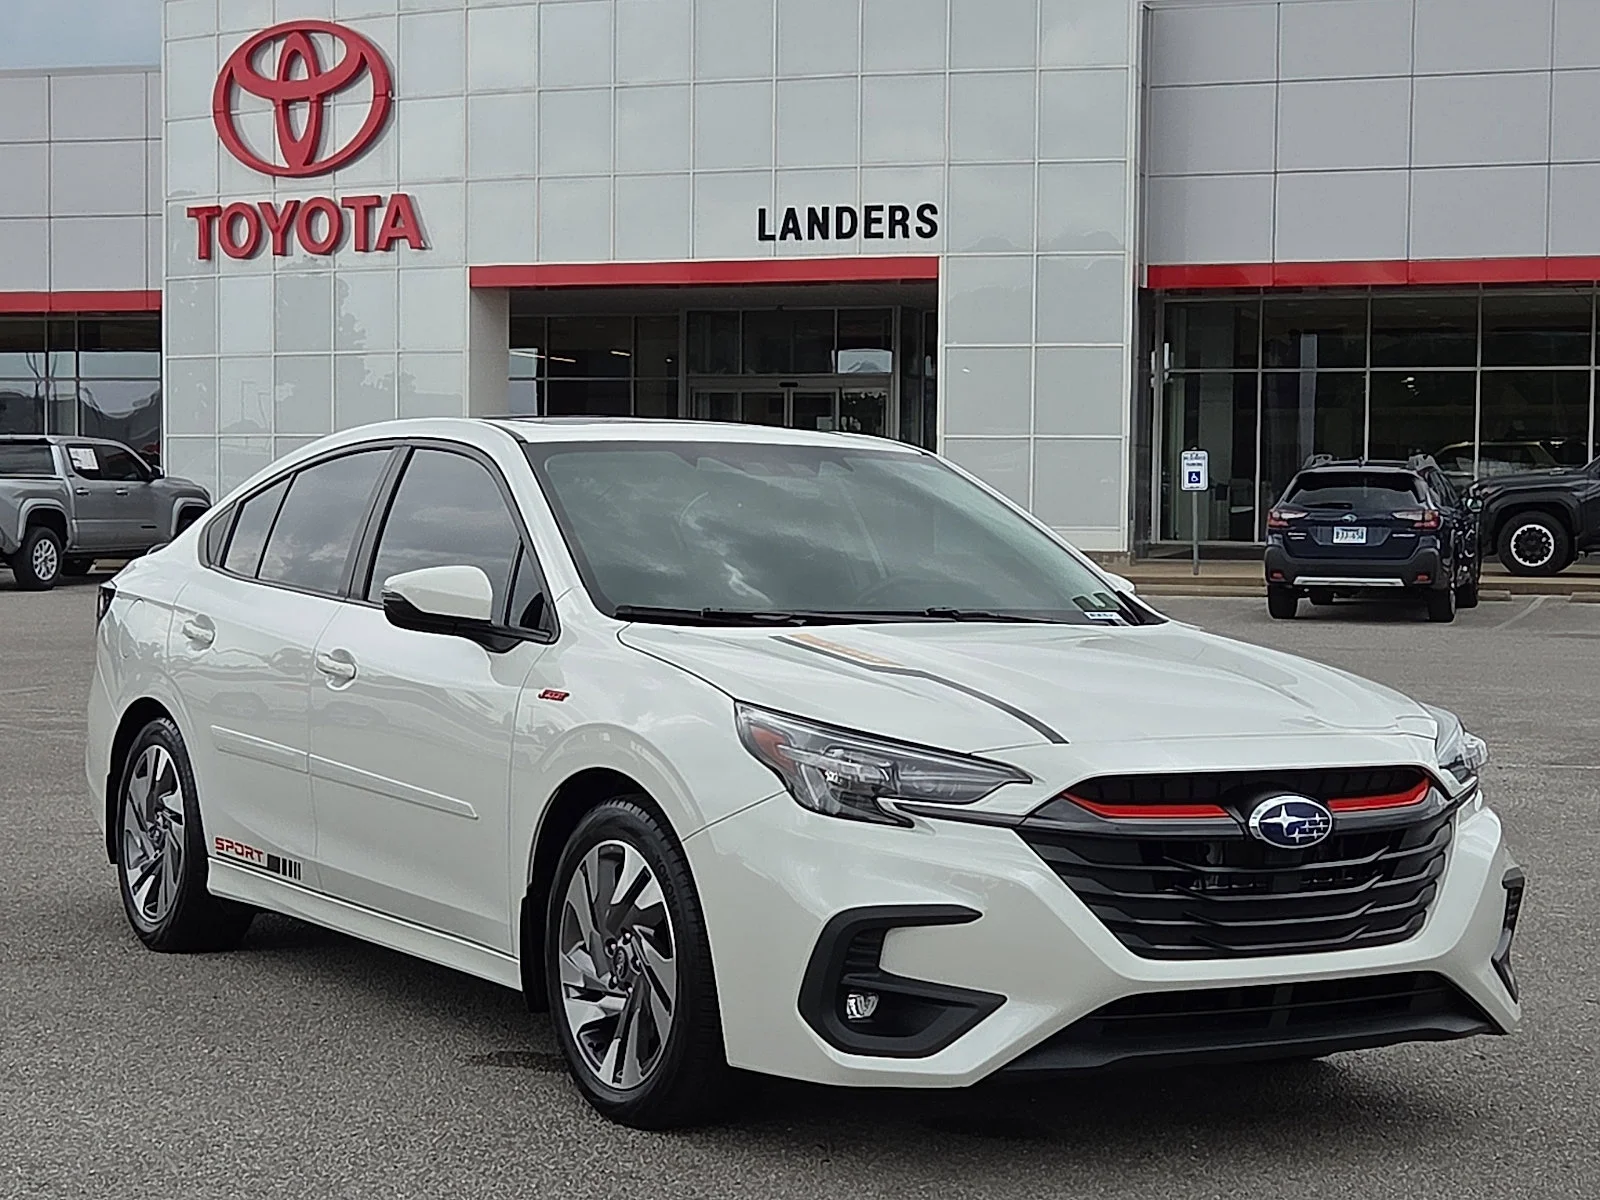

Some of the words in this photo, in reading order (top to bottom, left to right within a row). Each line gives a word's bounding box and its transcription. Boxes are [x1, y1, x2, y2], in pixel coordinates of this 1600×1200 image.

[186, 193, 425, 259] TOYOTA
[758, 203, 938, 241] LANDERS
[215, 836, 264, 863] SPORT
